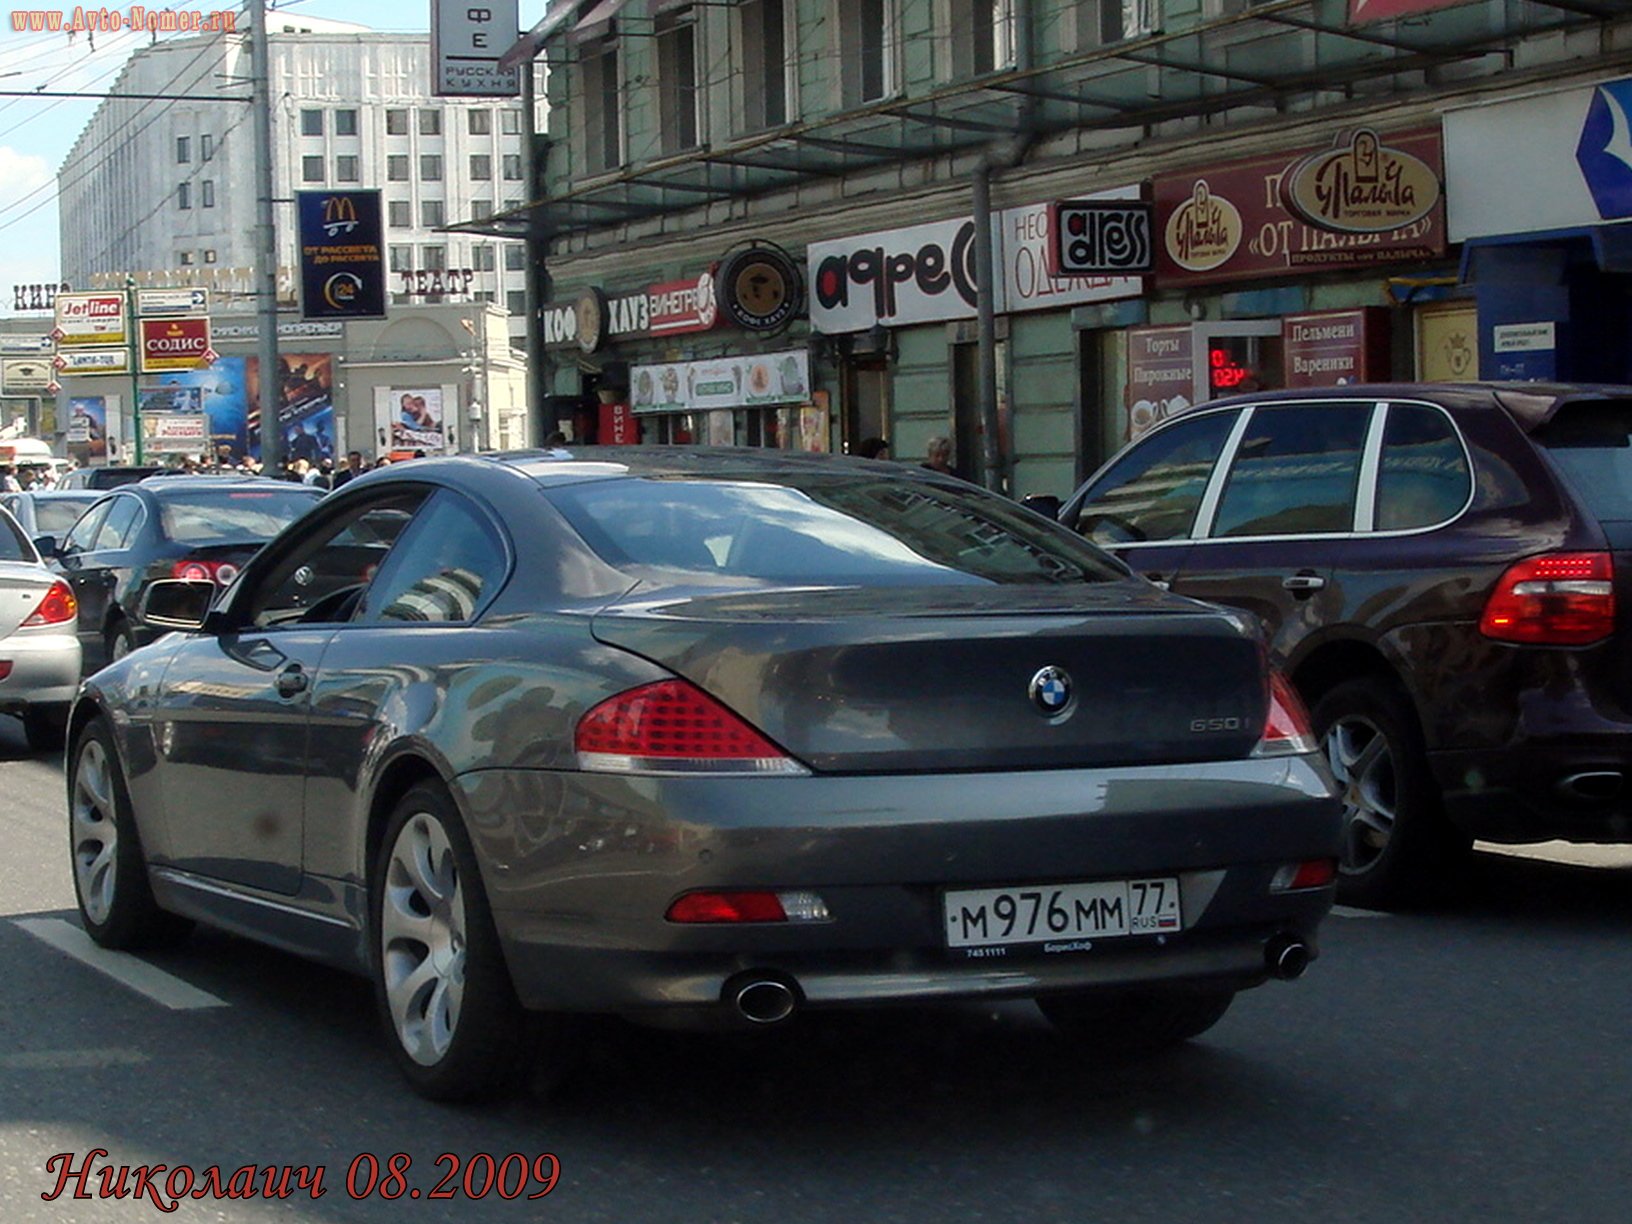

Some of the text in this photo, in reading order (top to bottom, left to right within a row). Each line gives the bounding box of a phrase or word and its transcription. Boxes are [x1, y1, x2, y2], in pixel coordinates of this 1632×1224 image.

[446, 79, 515, 88] КУХНЯ
[402, 269, 474, 294] ТЕАТР
[544, 294, 649, 343] КОФ ХАУЗ
[1292, 323, 1354, 342] Пельмени
[146, 338, 205, 351] СОДИС
[1146, 338, 1180, 354] Торты
[1294, 356, 1354, 374] Вареники
[1134, 366, 1192, 386] Пирожные
[961, 883, 1165, 939] М976ММ 77
[1132, 917, 1157, 928] RUS
